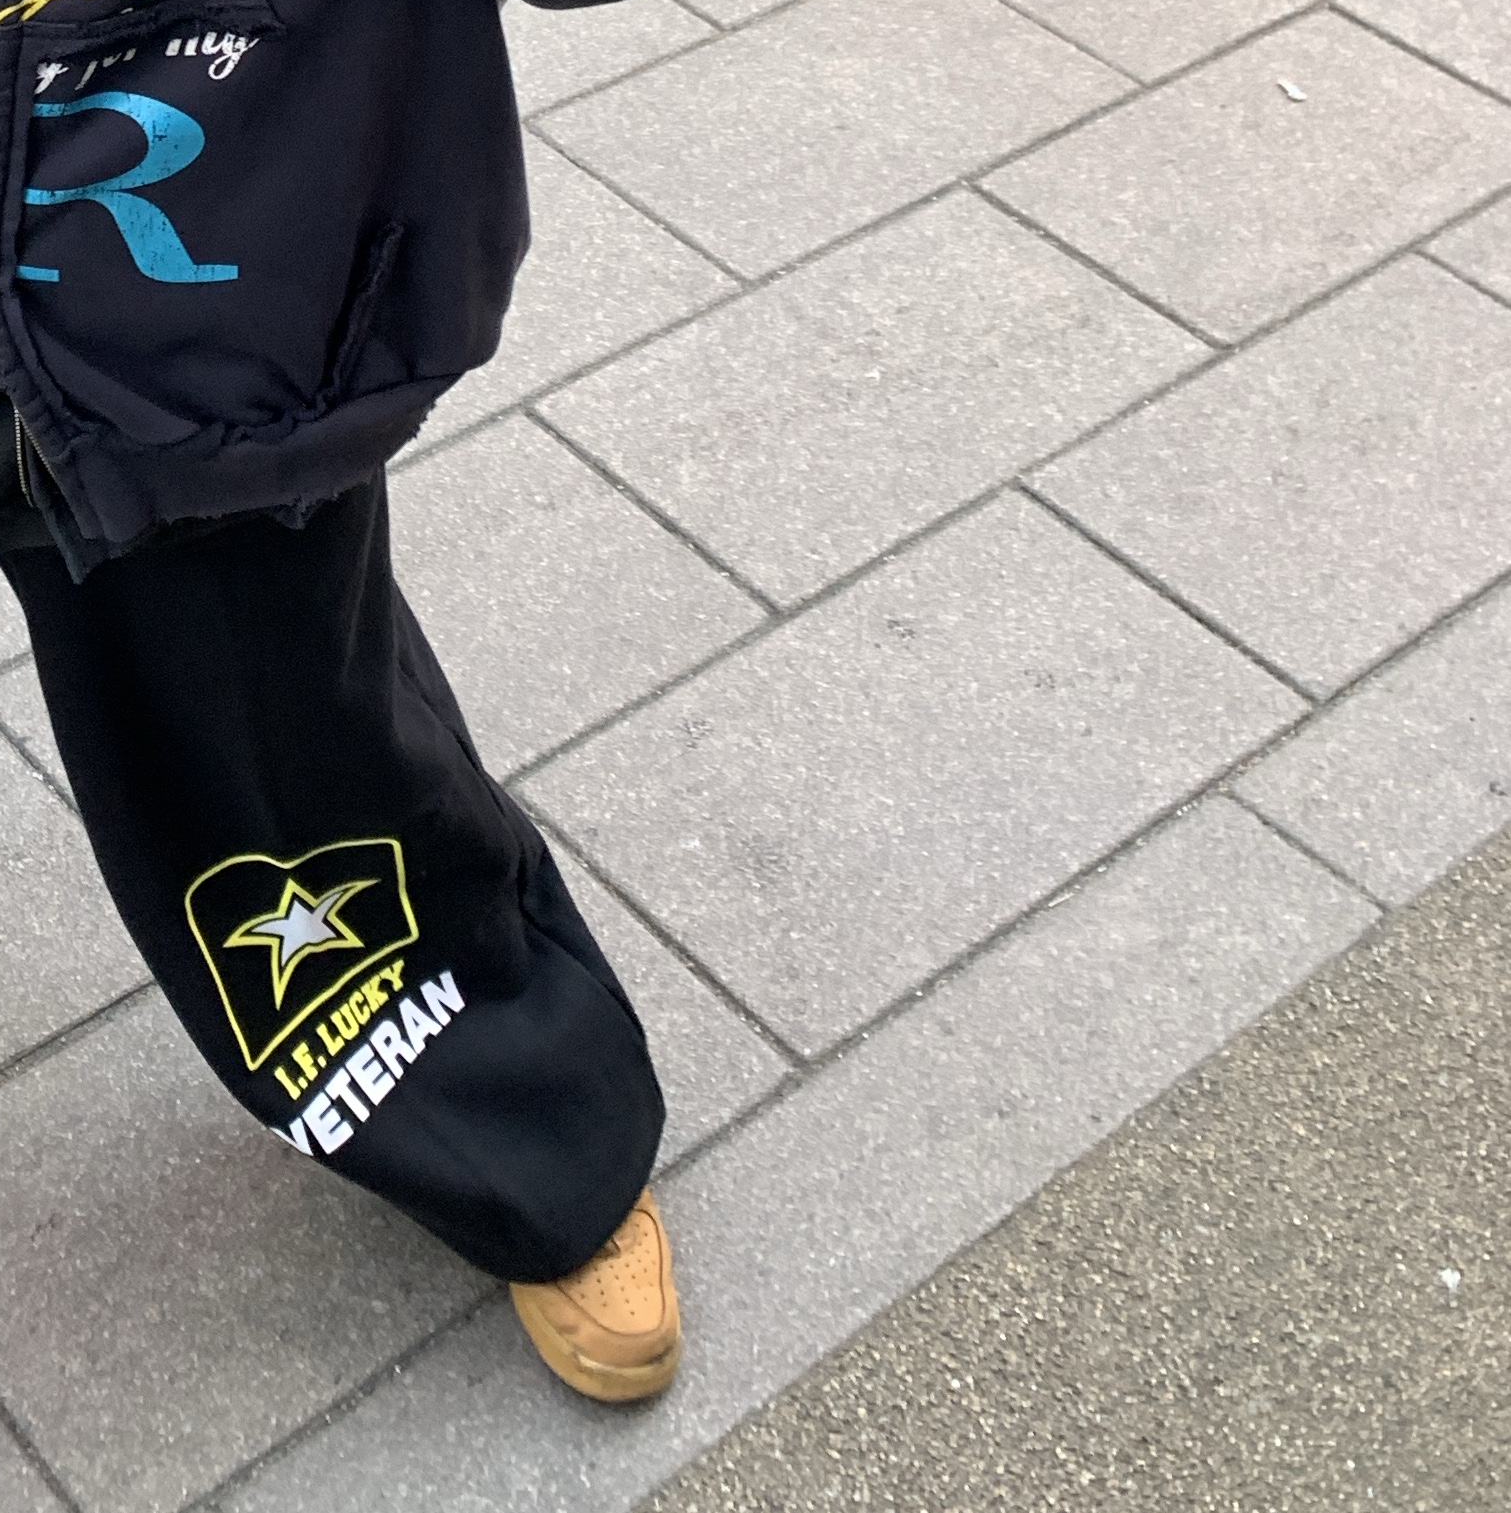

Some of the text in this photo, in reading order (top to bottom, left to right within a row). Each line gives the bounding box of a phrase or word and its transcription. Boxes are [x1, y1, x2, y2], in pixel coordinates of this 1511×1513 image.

[269, 970, 466, 1158] VETERAN
[274, 959, 406, 1101] I.F. LUCKY
